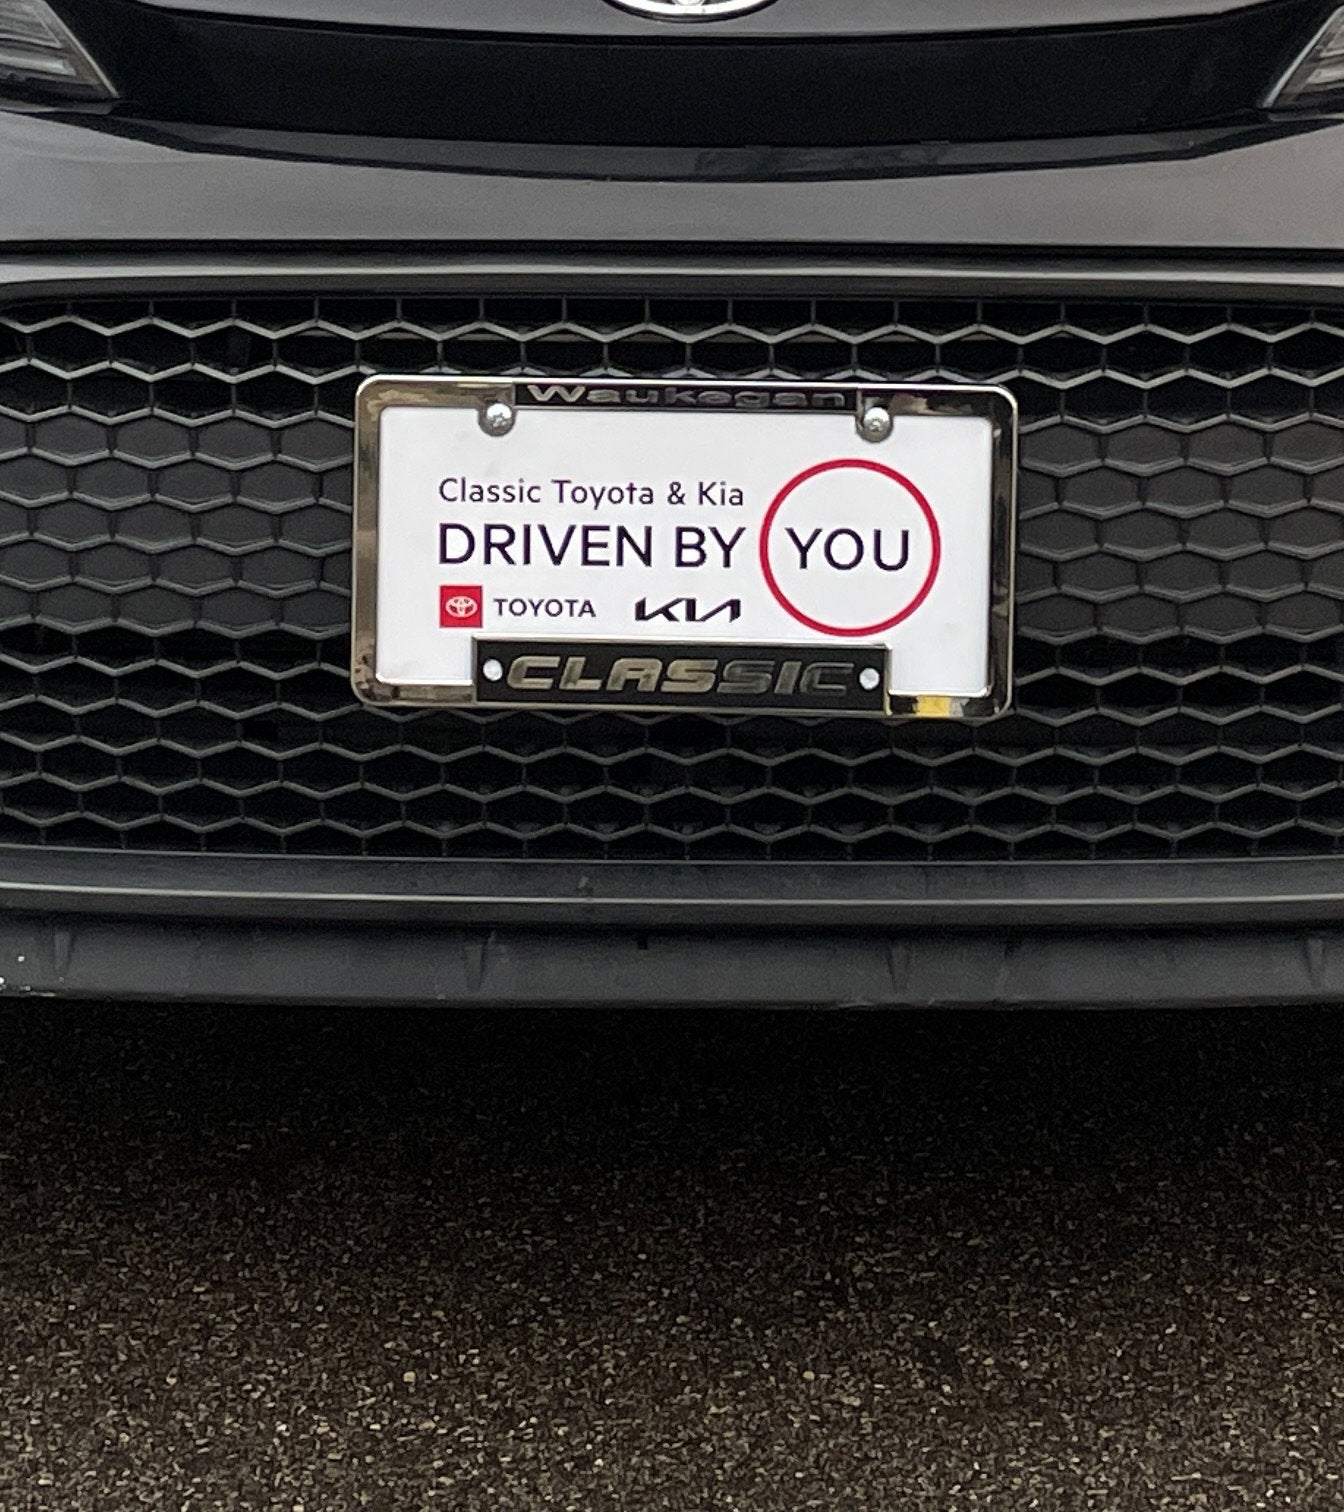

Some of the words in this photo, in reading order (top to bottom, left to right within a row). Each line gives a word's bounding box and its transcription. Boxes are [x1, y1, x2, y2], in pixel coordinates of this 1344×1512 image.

[527, 385, 845, 409] Waukegan
[439, 477, 541, 503] Classic
[551, 479, 654, 510] Toyota
[667, 481, 686, 505] &
[699, 481, 744, 506] Kia
[439, 523, 652, 567] DRIVEN
[675, 526, 746, 568] BY
[785, 527, 910, 572] YOU
[494, 598, 596, 618] TOYOTA
[634, 597, 741, 623] KIA
[507, 655, 854, 697] CLASSIC
